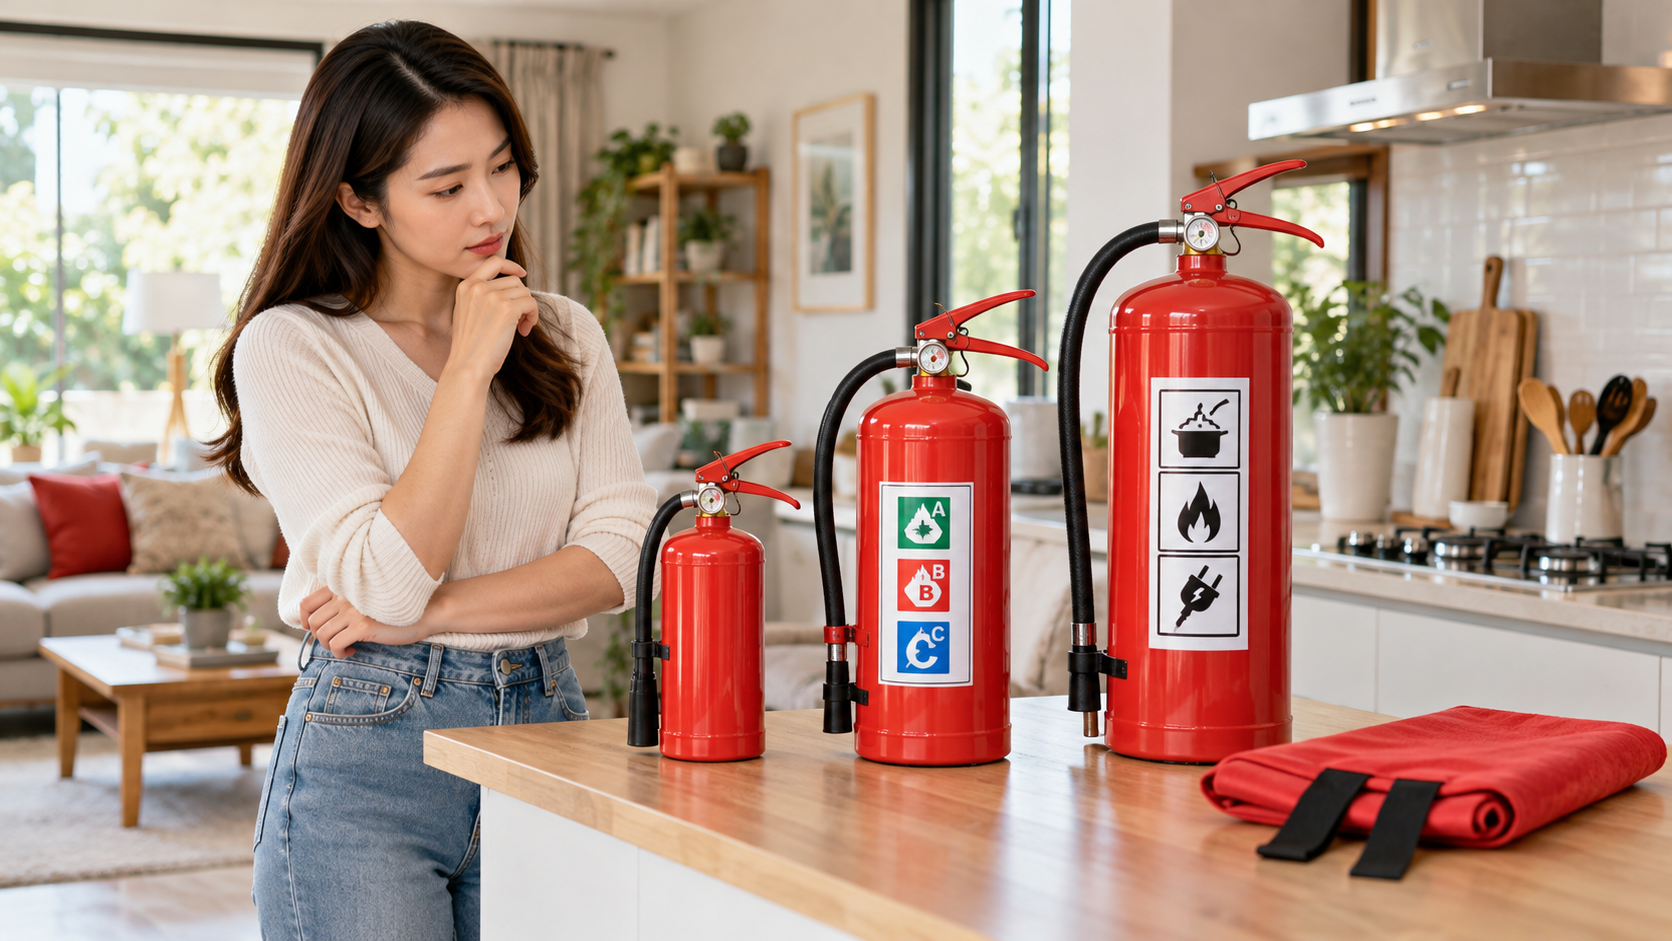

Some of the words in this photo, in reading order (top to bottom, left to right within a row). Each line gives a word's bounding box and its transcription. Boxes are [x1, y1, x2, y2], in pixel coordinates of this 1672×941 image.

[932, 501, 946, 517] A
[932, 564, 945, 580] B
[919, 585, 934, 601] B
[931, 626, 945, 642] C
